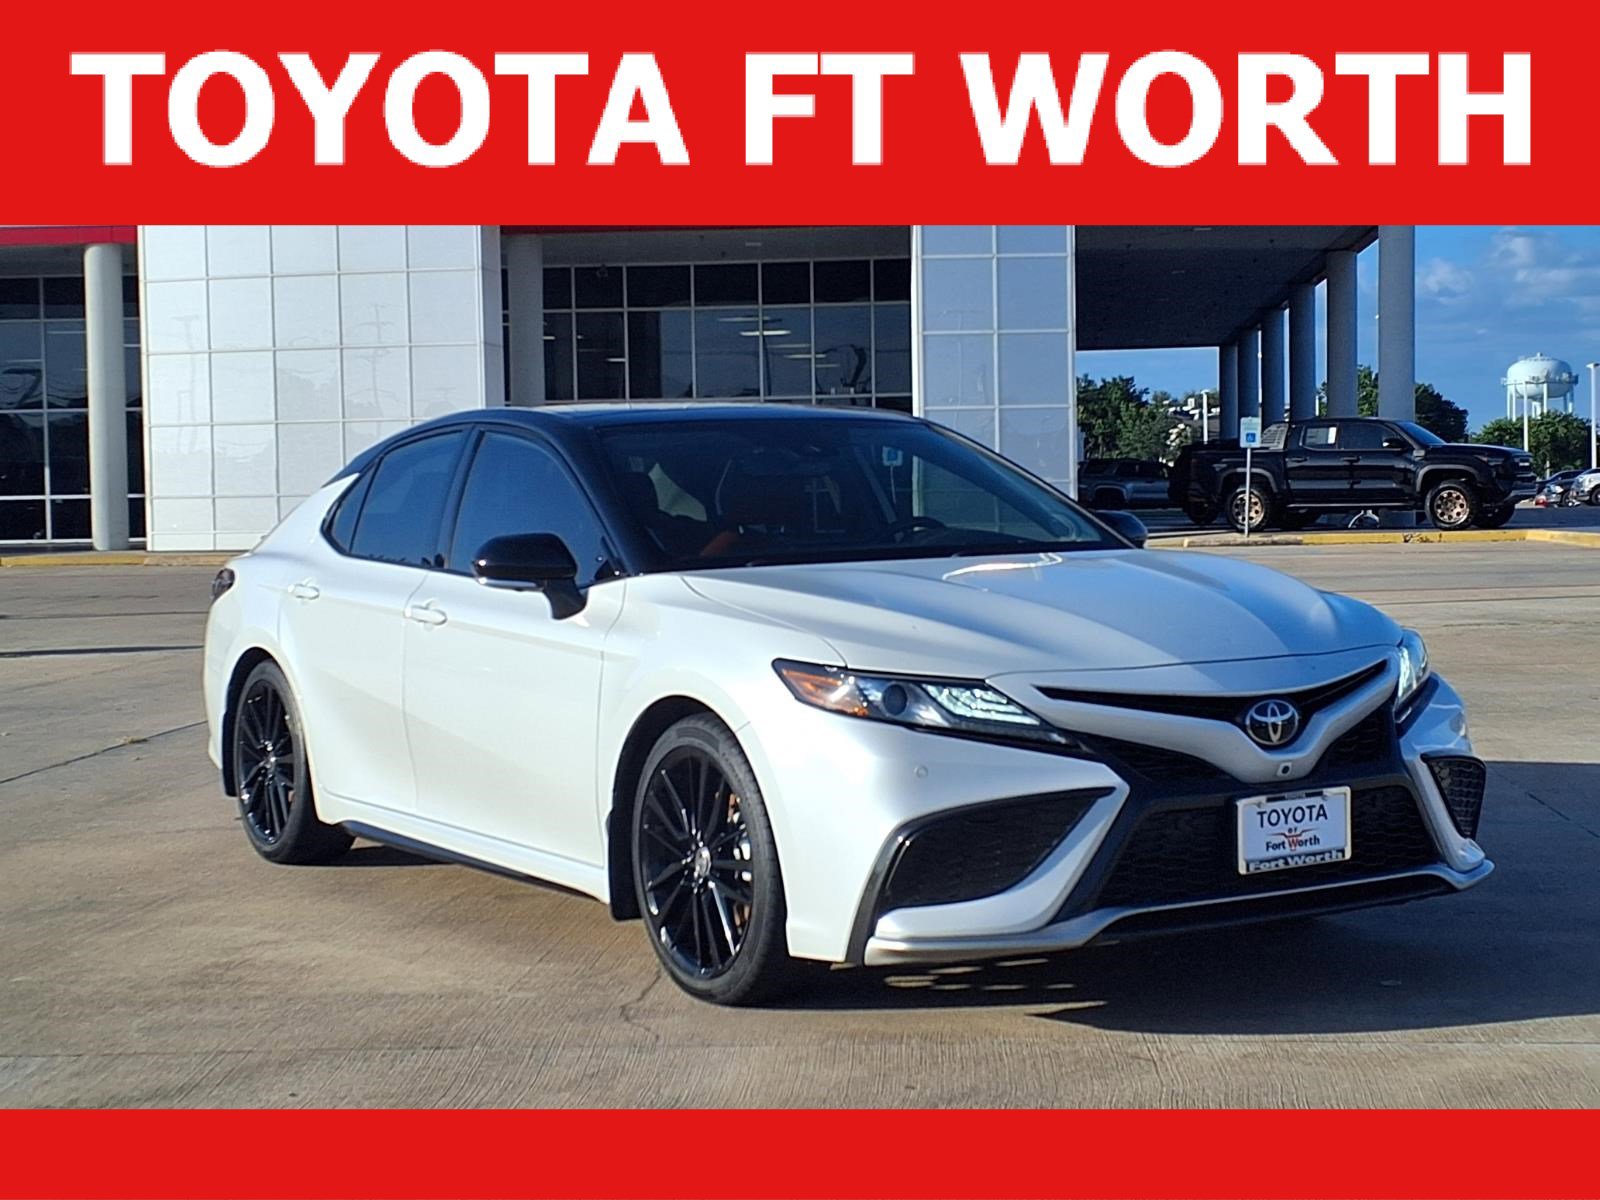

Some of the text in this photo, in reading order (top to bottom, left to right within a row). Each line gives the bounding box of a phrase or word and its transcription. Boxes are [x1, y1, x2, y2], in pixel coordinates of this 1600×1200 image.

[1257, 804, 1328, 828] TOYOTA
[1266, 835, 1320, 852] Fort Worth
[1249, 850, 1344, 871] Fort Worth
